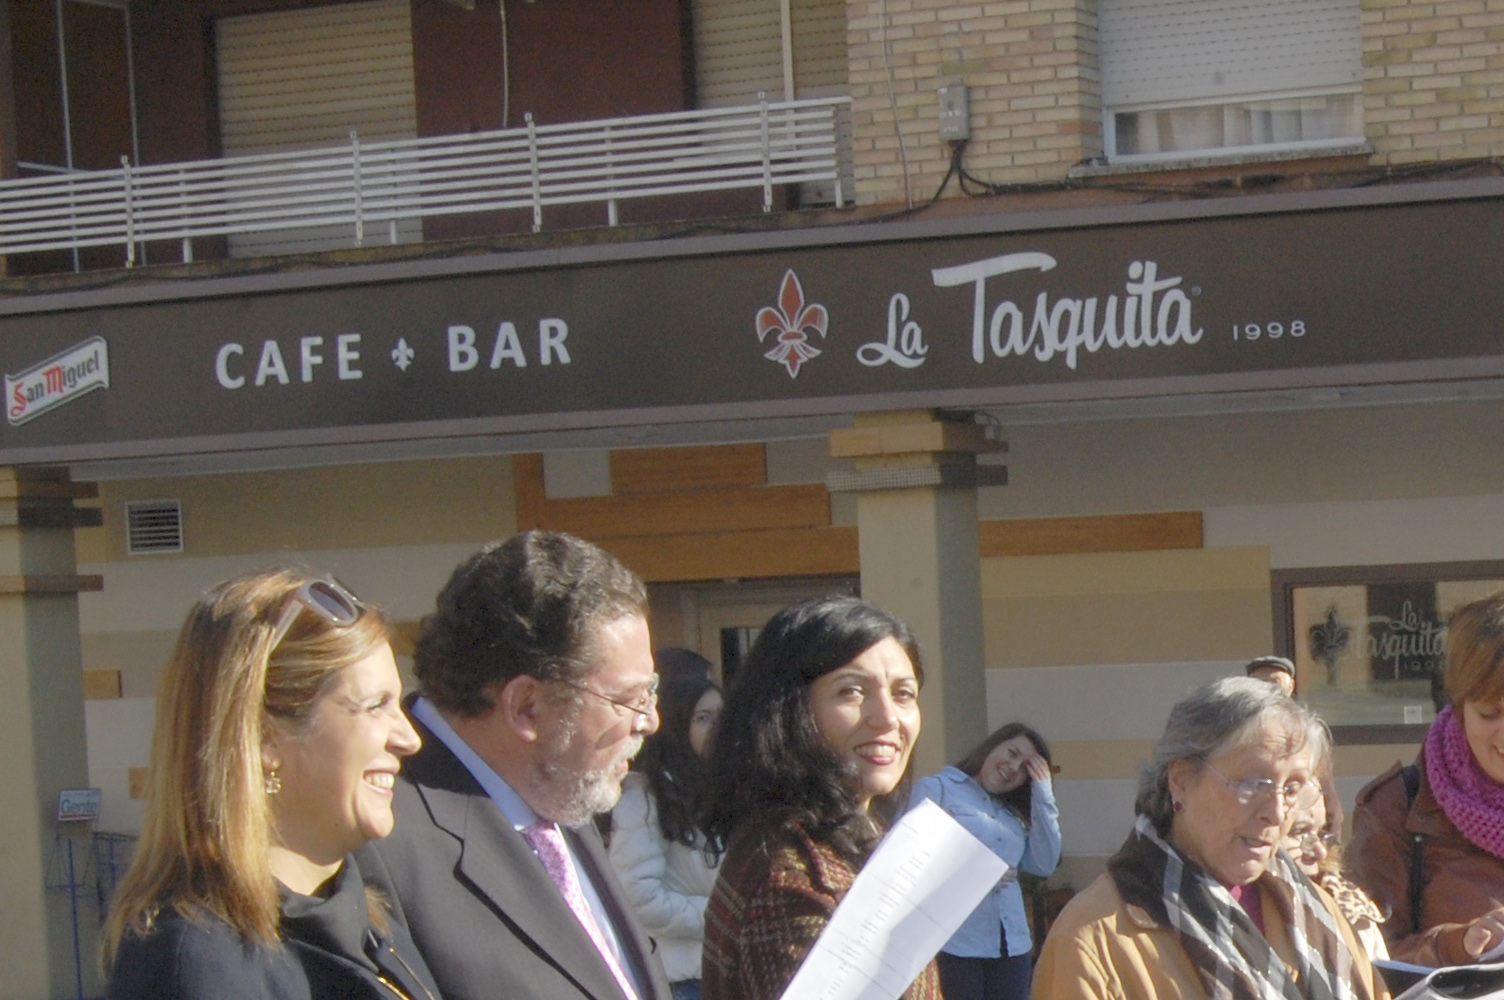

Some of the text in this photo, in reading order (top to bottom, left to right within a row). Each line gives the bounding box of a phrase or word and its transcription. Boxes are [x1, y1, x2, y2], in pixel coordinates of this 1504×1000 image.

[856, 252, 1204, 369] La Tasquita
[1233, 319, 1307, 341] 1998
[10, 350, 100, 417] San Miguel
[214, 317, 572, 389] CAFE BAR
[1389, 600, 1418, 632] La
